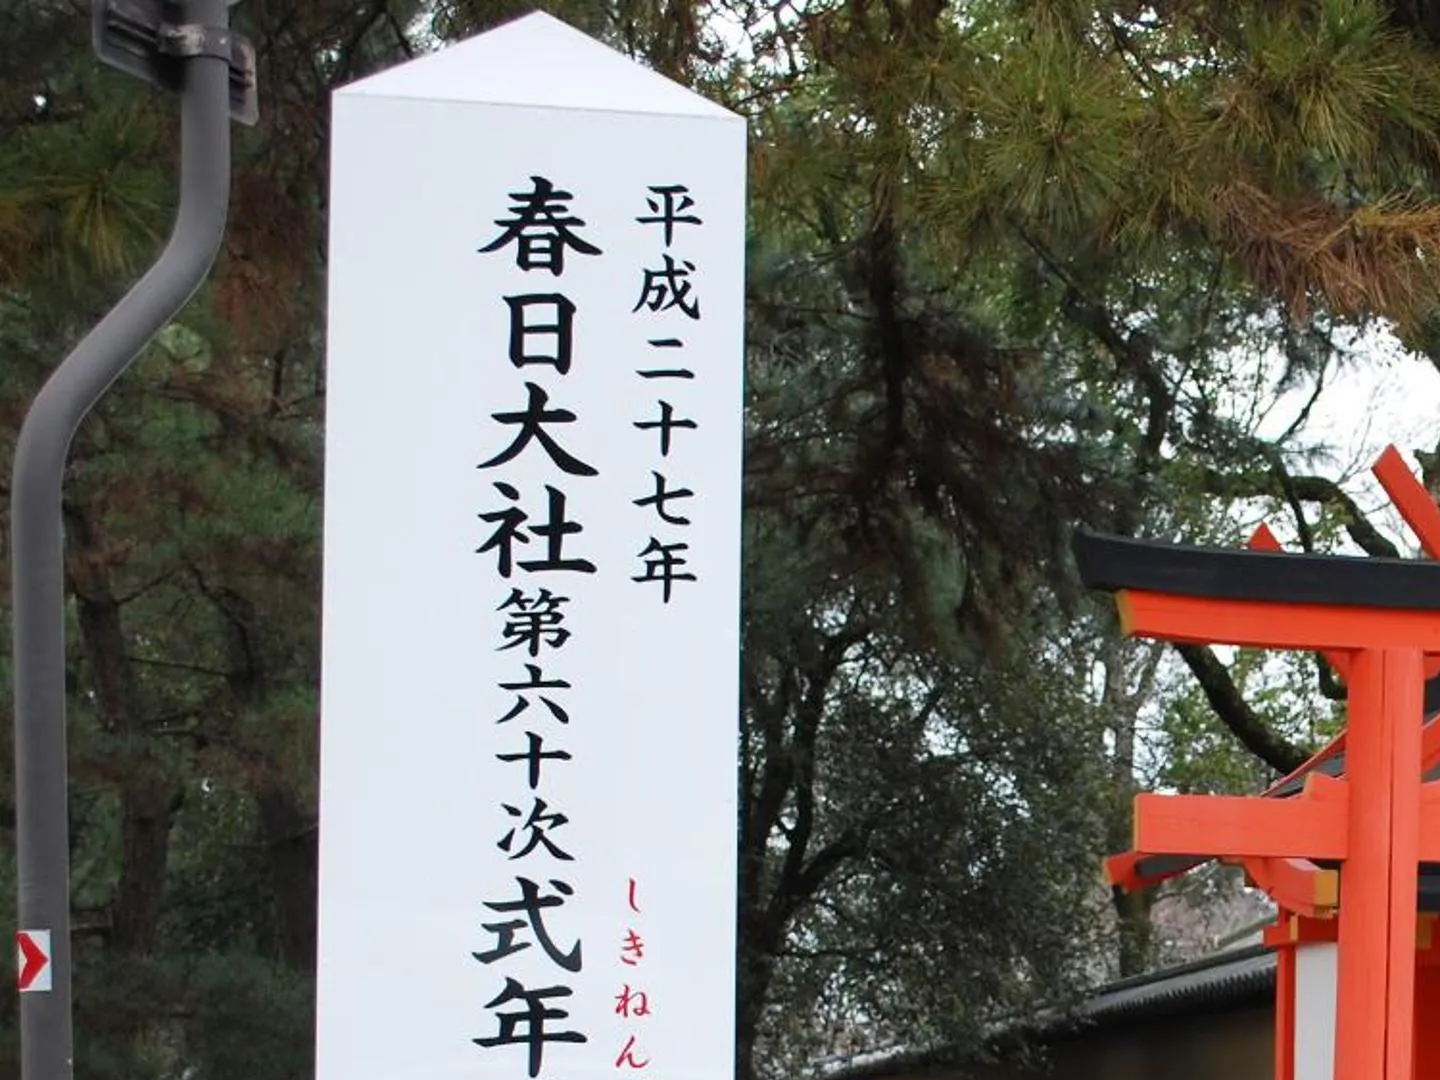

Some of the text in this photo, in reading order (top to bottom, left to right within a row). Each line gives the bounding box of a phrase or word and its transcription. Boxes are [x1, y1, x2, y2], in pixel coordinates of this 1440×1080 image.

[631, 185, 703, 604] 平成二十七年
